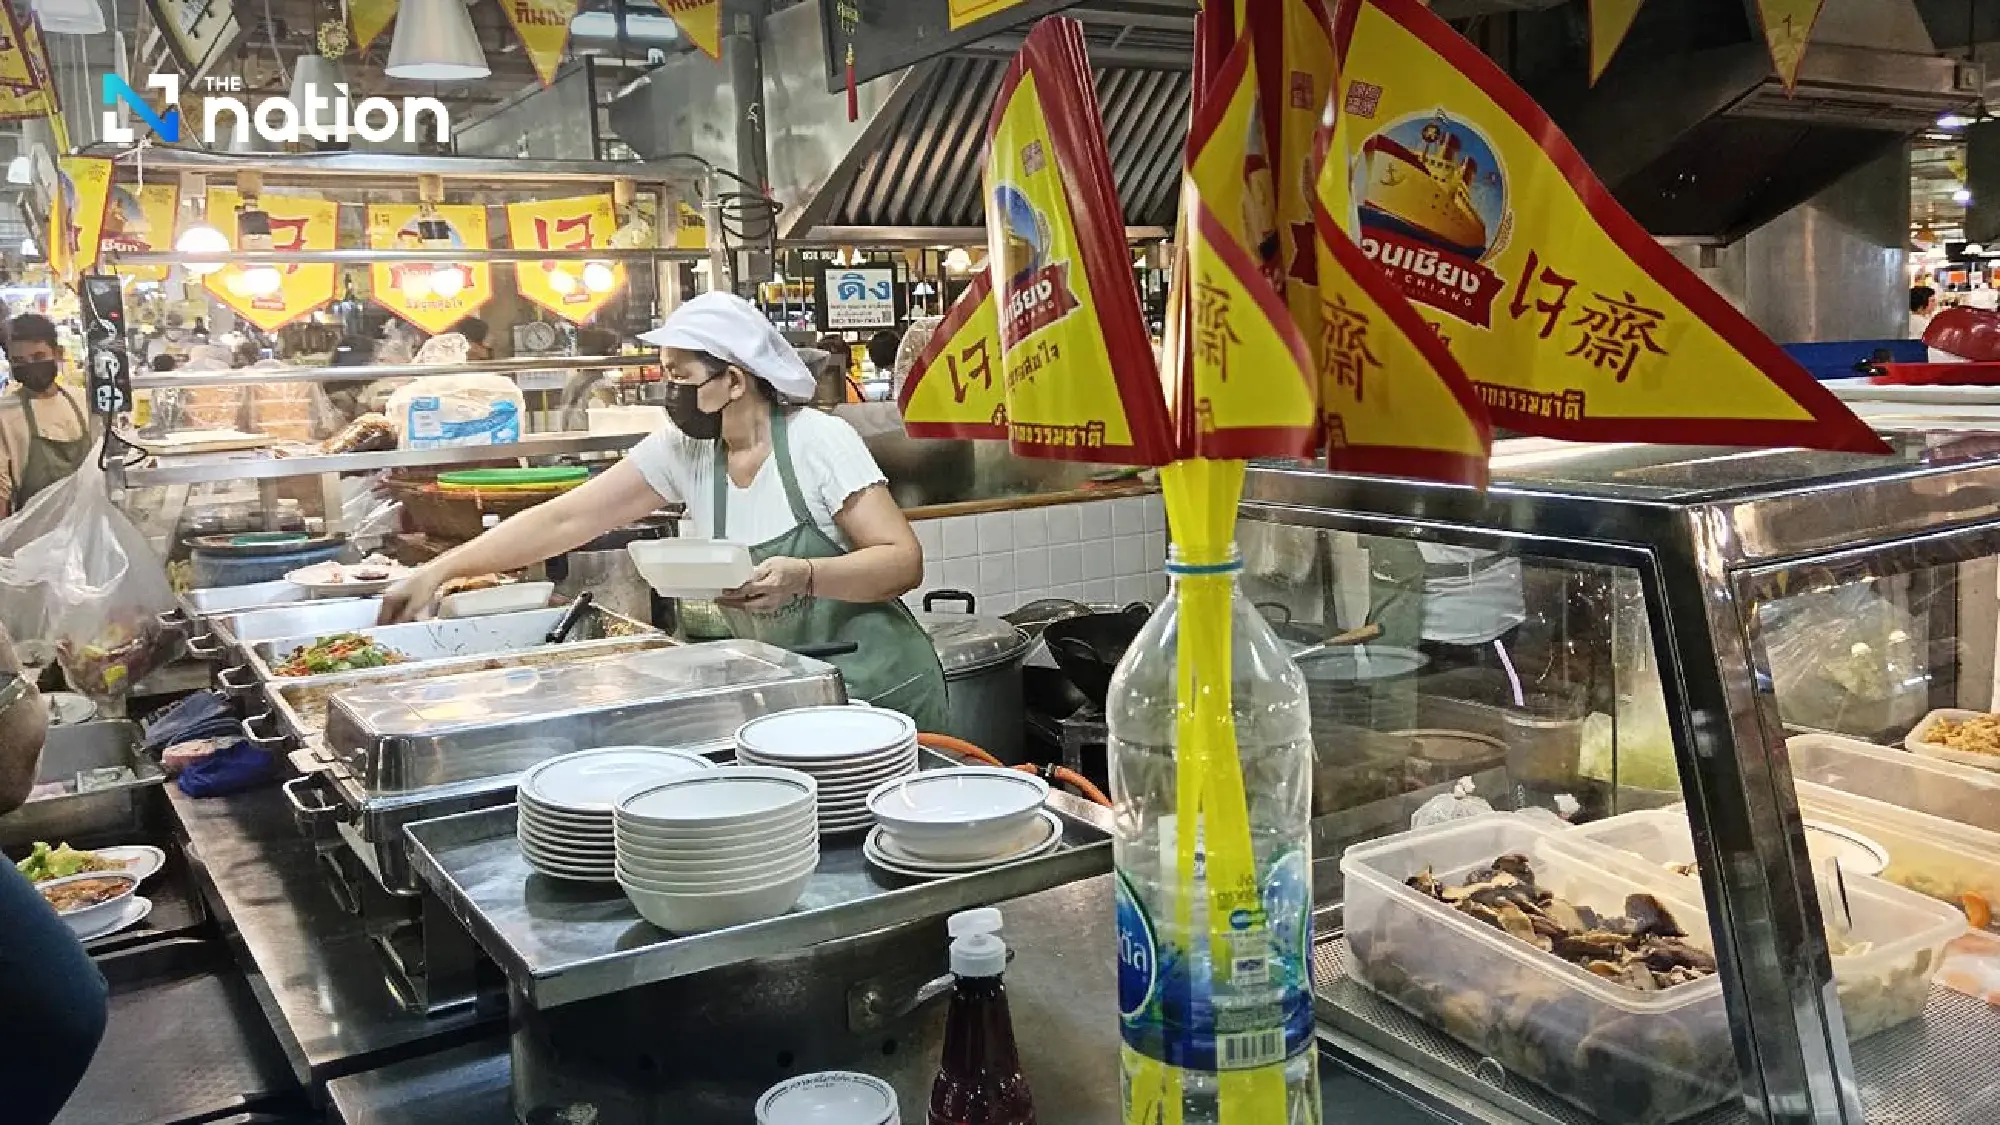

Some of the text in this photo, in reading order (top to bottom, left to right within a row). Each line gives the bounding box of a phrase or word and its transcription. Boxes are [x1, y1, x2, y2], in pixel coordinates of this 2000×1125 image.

[1361, 238, 1481, 294] วนเชียง
[1472, 382, 1586, 422] ากธรรมชาติ
[1009, 420, 1106, 448] ากธรรมชาติ
